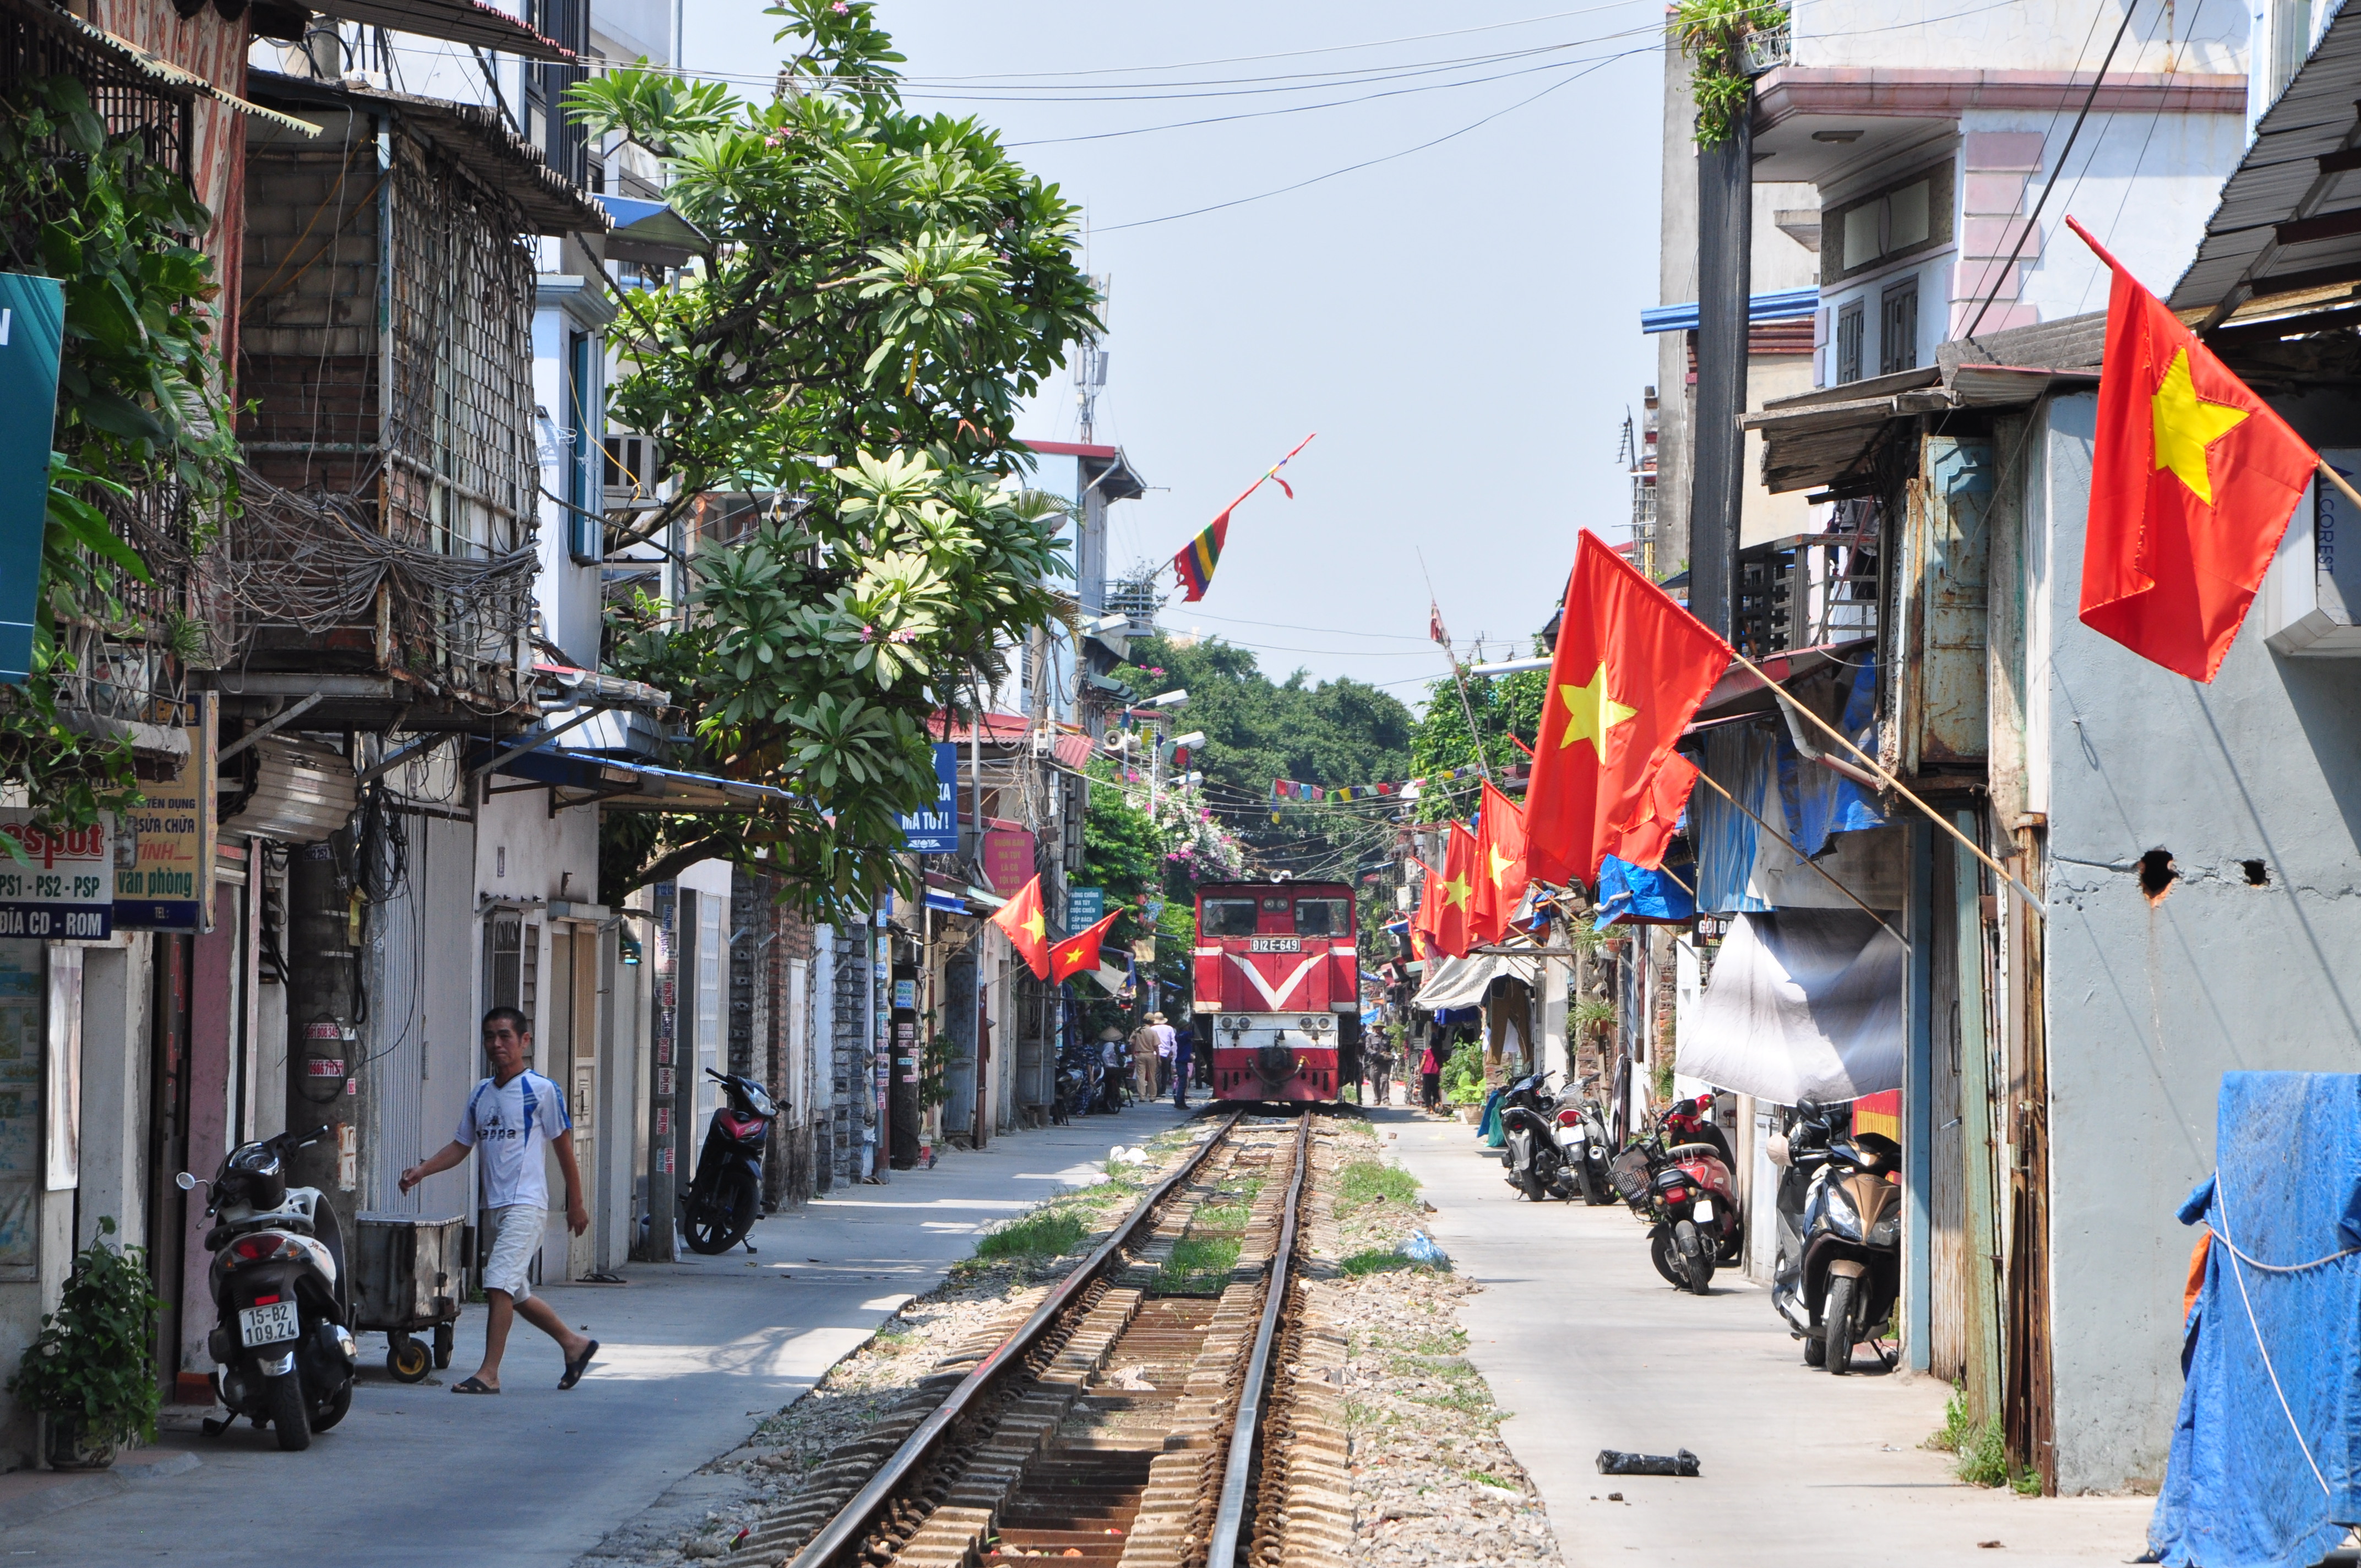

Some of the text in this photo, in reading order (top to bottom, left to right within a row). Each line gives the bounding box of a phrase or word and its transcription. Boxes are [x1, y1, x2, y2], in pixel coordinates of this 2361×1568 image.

[168, 799, 195, 812] DỤNG
[138, 813, 195, 833] SỬA CHỮA
[36, 875, 61, 897] PS2
[74, 876, 100, 897] PSP
[148, 867, 192, 898] phòng
[29, 911, 50, 934] CD
[66, 912, 102, 936] ROM
[249, 1305, 289, 1326] 15-B2
[246, 1320, 295, 1343] 109.24
